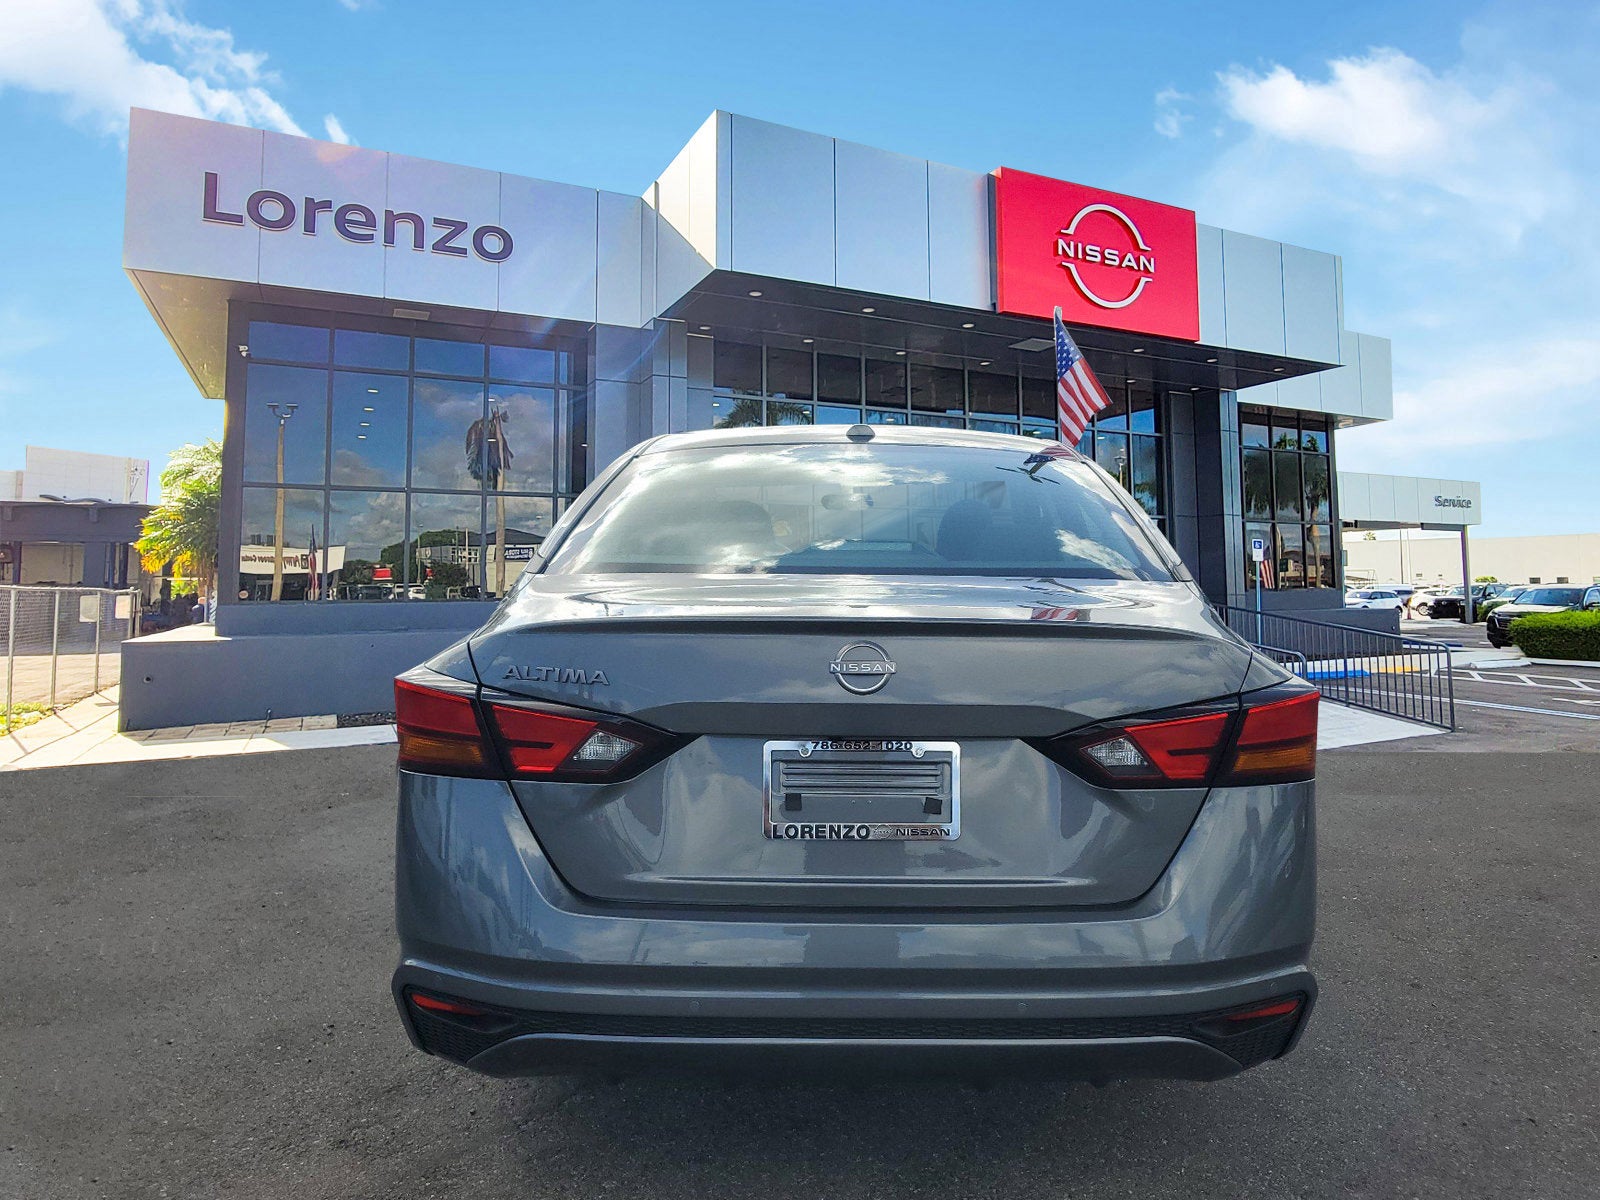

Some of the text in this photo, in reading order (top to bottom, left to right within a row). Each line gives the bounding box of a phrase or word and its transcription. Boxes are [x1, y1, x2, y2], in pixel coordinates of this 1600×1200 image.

[202, 171, 514, 263] Lorenzo
[1057, 238, 1155, 273] NISSAN
[1434, 495, 1472, 509] Service
[502, 664, 610, 685] ALTIMA
[830, 663, 896, 672] NISSAN
[772, 823, 871, 840] LORENZO
[895, 828, 951, 836] NISSAN
